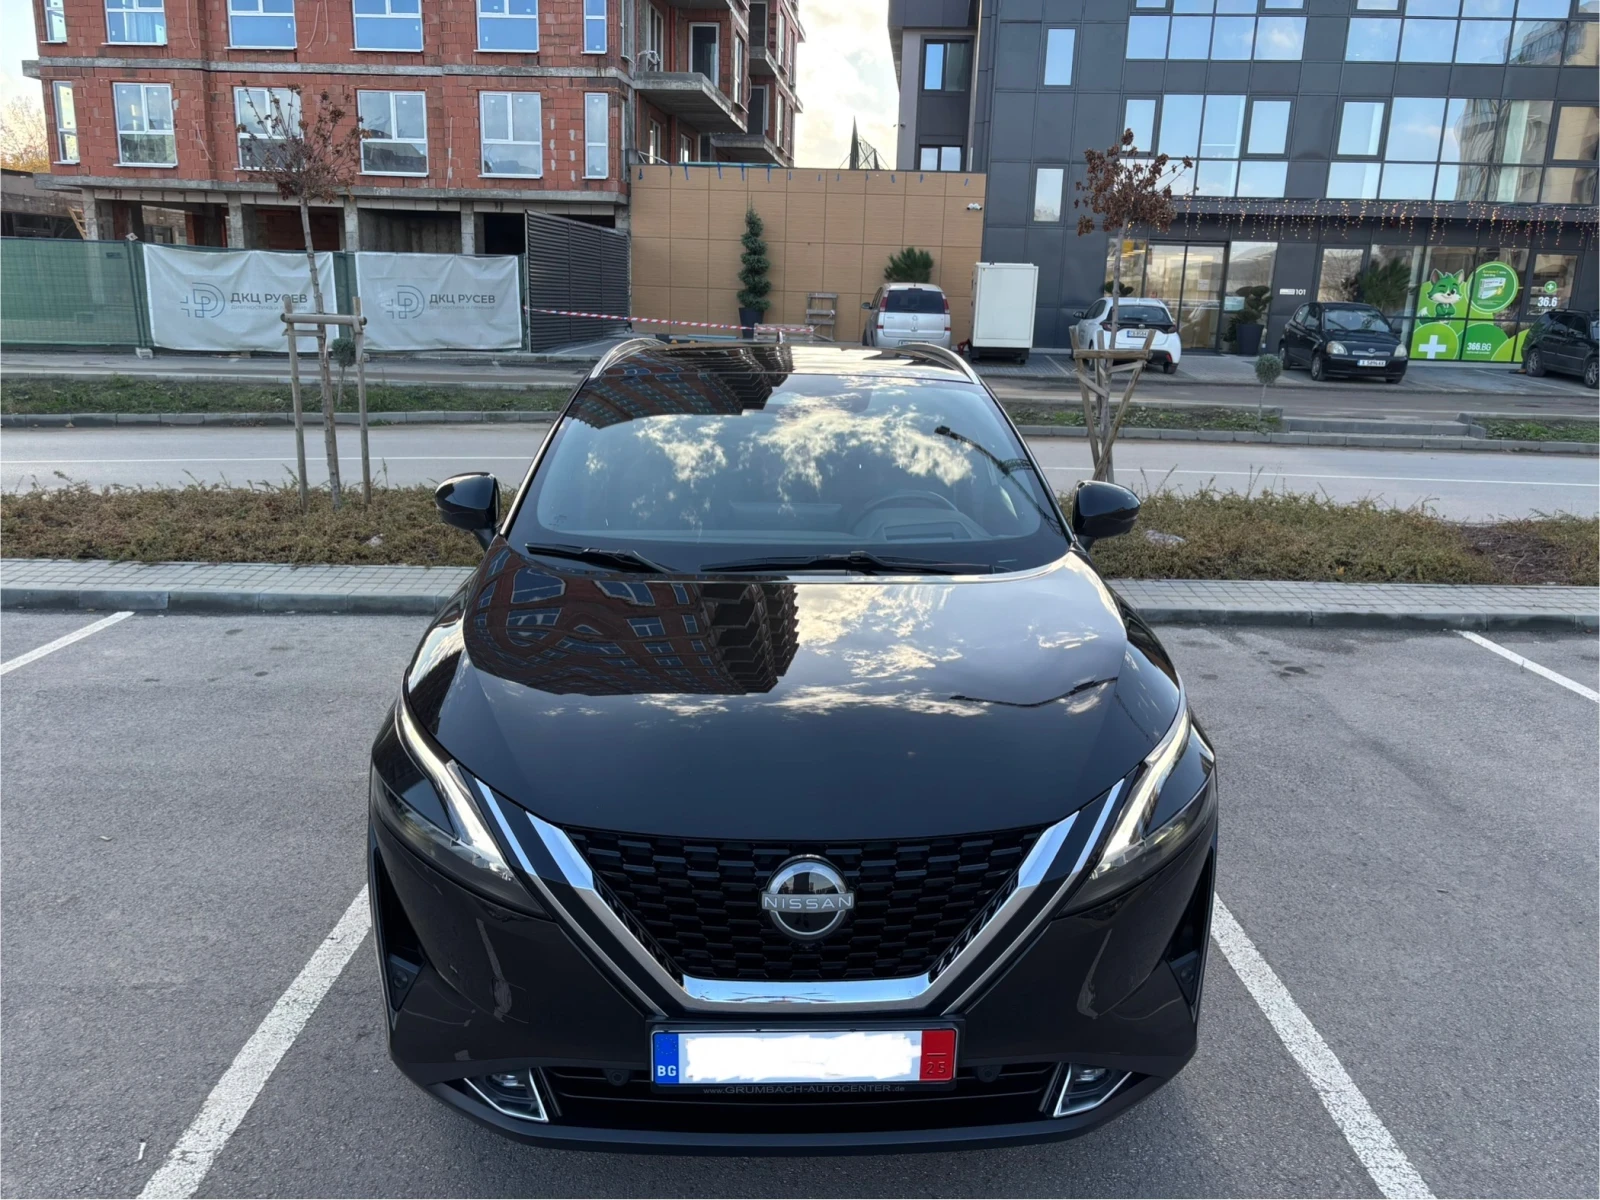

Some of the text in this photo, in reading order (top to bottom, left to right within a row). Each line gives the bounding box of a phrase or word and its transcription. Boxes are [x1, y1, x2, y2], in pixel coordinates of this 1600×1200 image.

[230, 292, 262, 304] ДКЦ
[1295, 288, 1307, 296] 101
[429, 293, 496, 305] ДКЦ РУСЕВ
[1537, 296, 1558, 307] 36.6
[764, 896, 852, 909] NISSAN
[657, 1065, 677, 1077] BG
[926, 1061, 946, 1075] 25
[703, 1084, 905, 1094] www.GRUMBACH-AUTOCENTER.de
